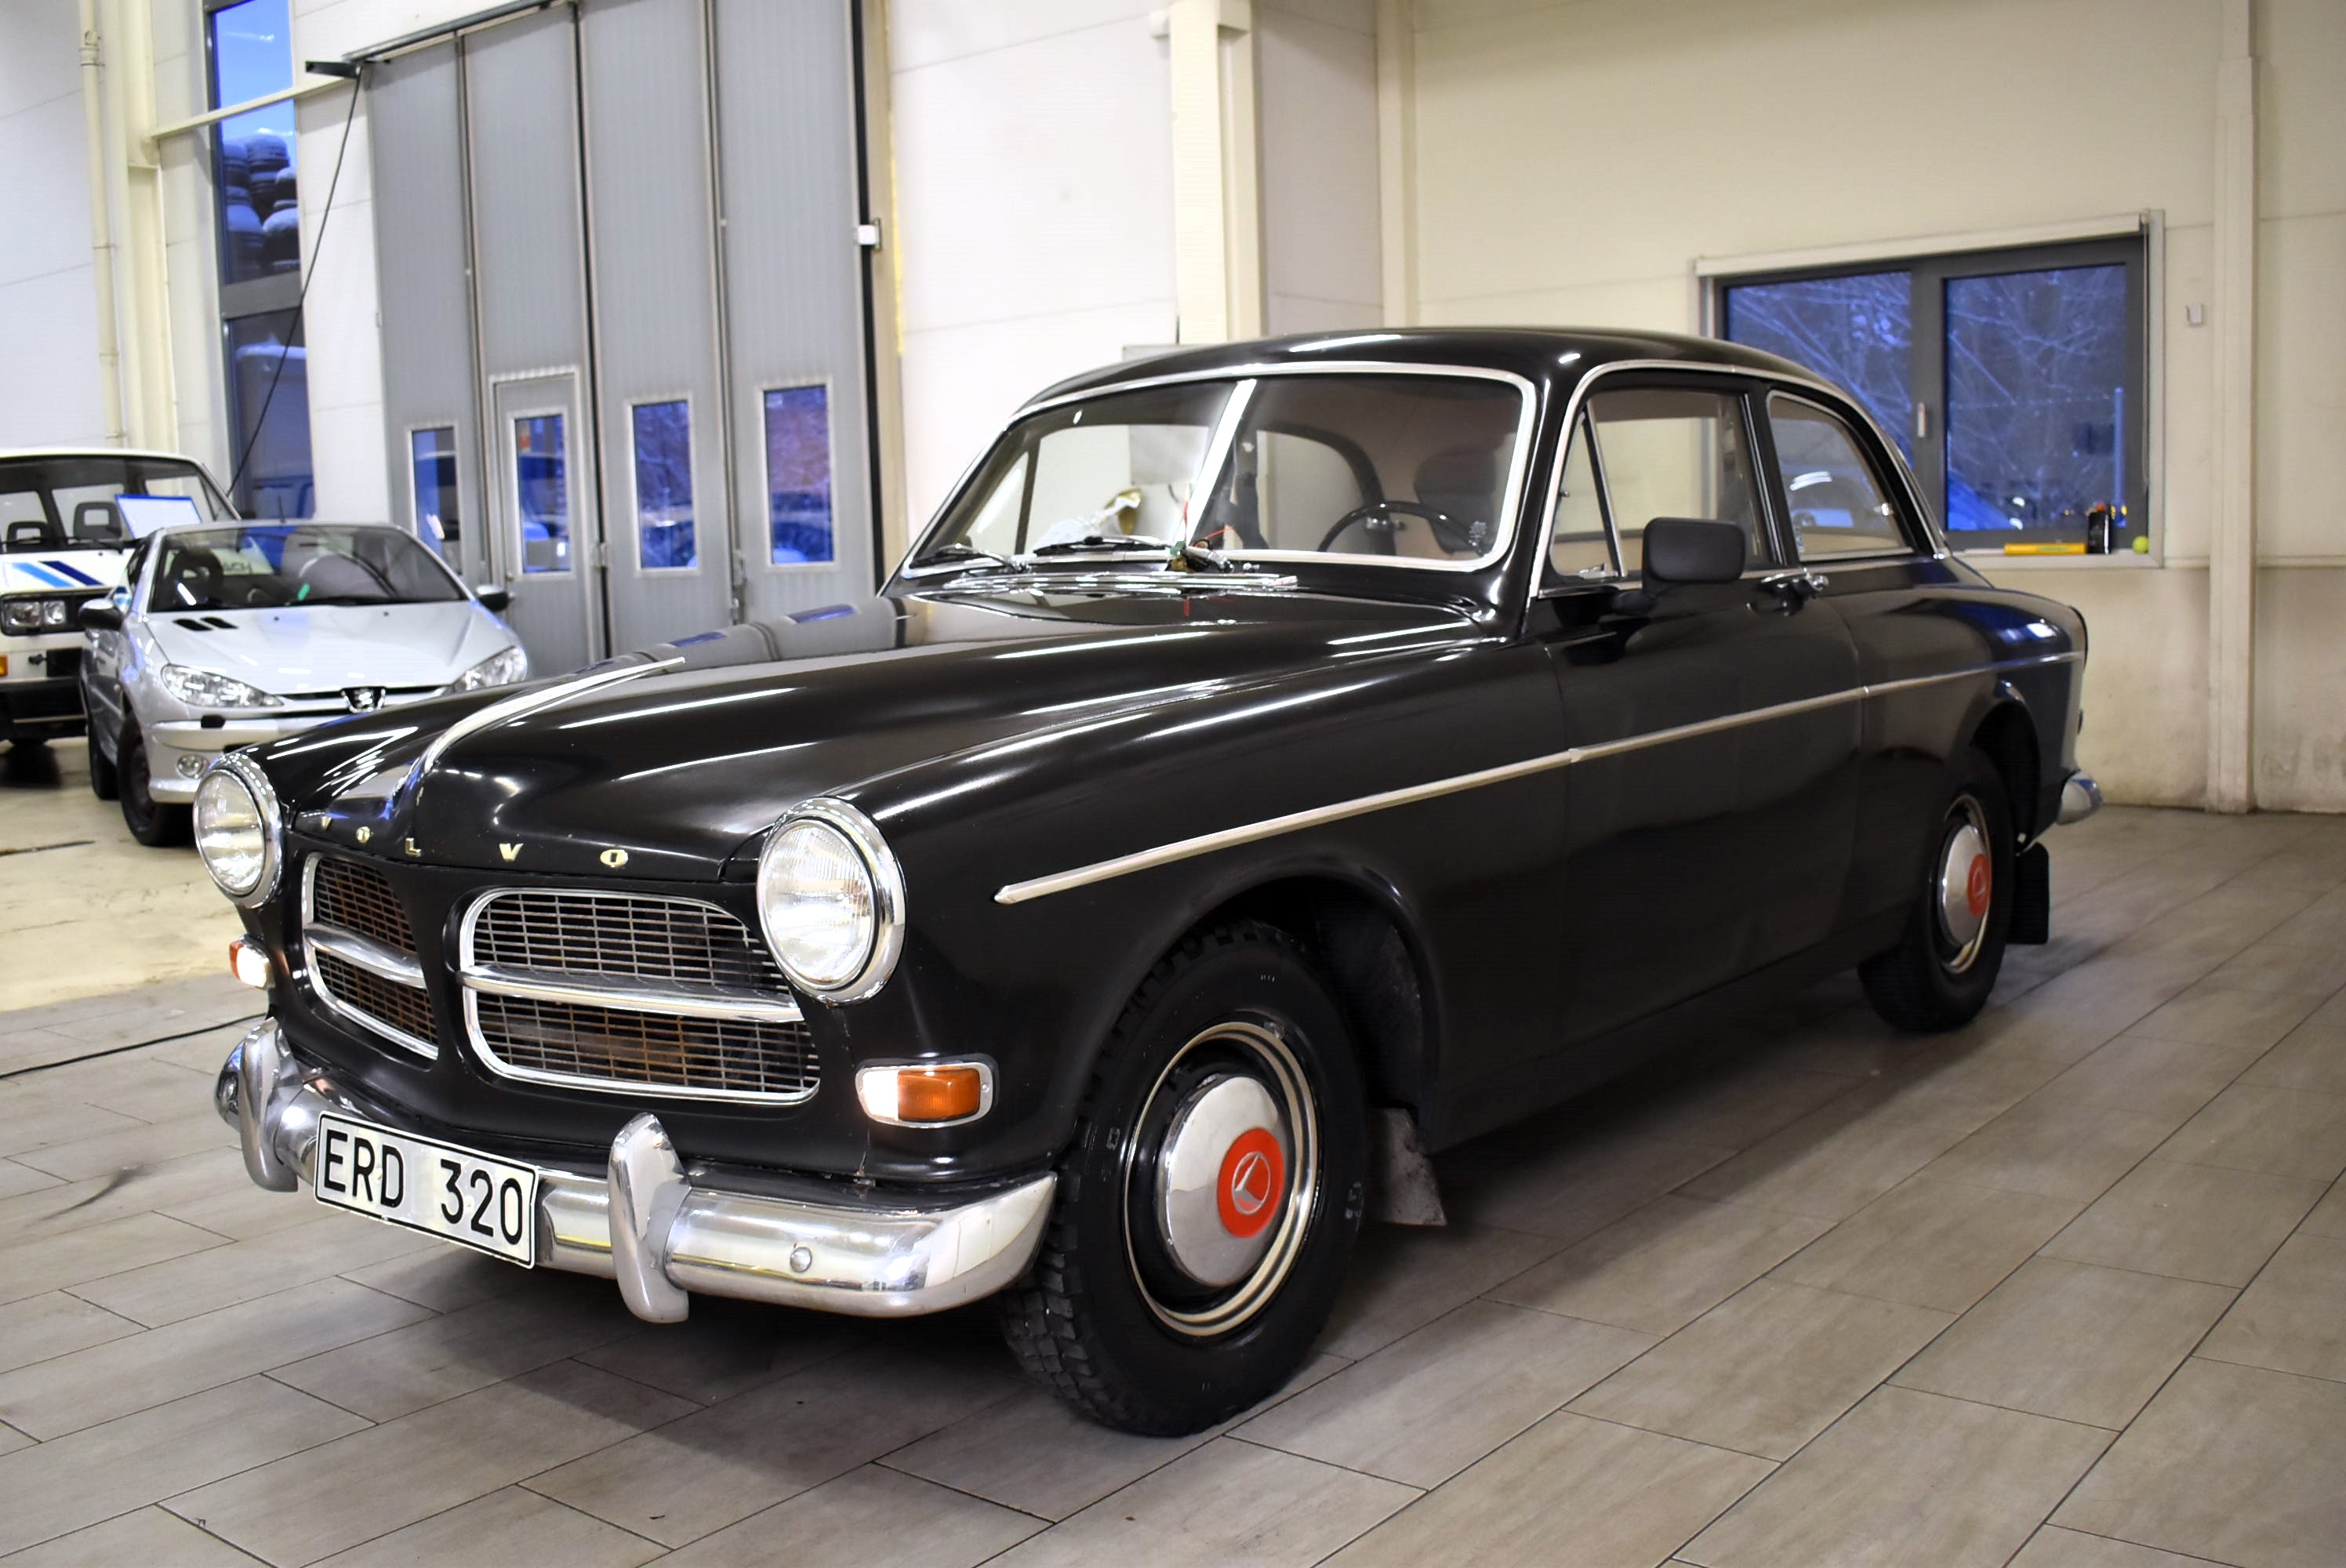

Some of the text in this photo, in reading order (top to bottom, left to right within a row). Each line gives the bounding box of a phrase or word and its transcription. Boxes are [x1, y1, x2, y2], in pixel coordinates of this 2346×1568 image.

[321, 815, 629, 868] VOLVO
[324, 1129, 523, 1245] ERD 320
